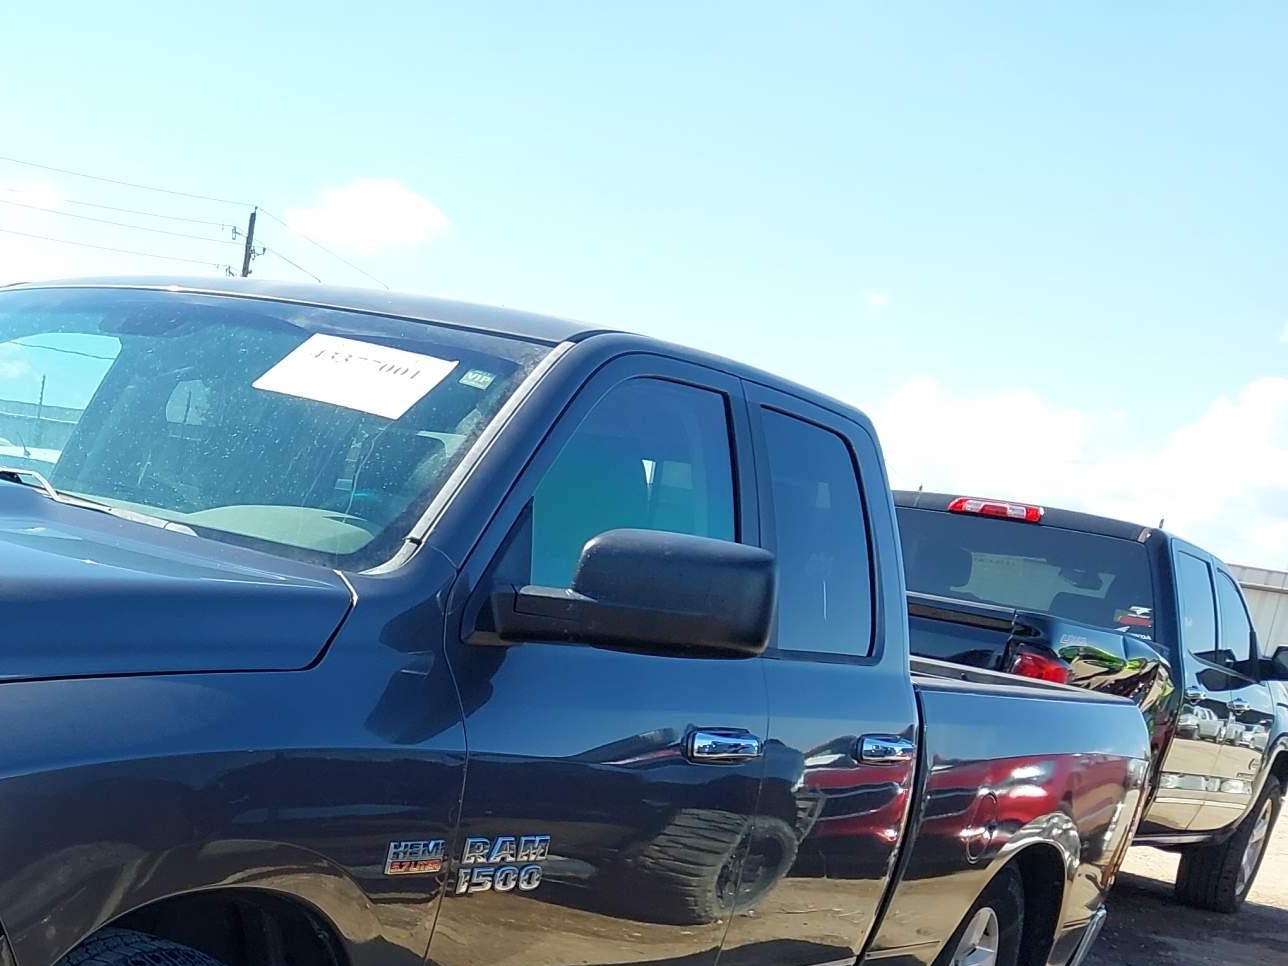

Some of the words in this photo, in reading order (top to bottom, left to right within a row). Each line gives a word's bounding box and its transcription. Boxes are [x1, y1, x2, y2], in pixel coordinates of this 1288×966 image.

[467, 371, 491, 383] VIP
[390, 839, 445, 858] HEMI
[462, 836, 551, 864] RAM
[456, 865, 543, 894] 1500
